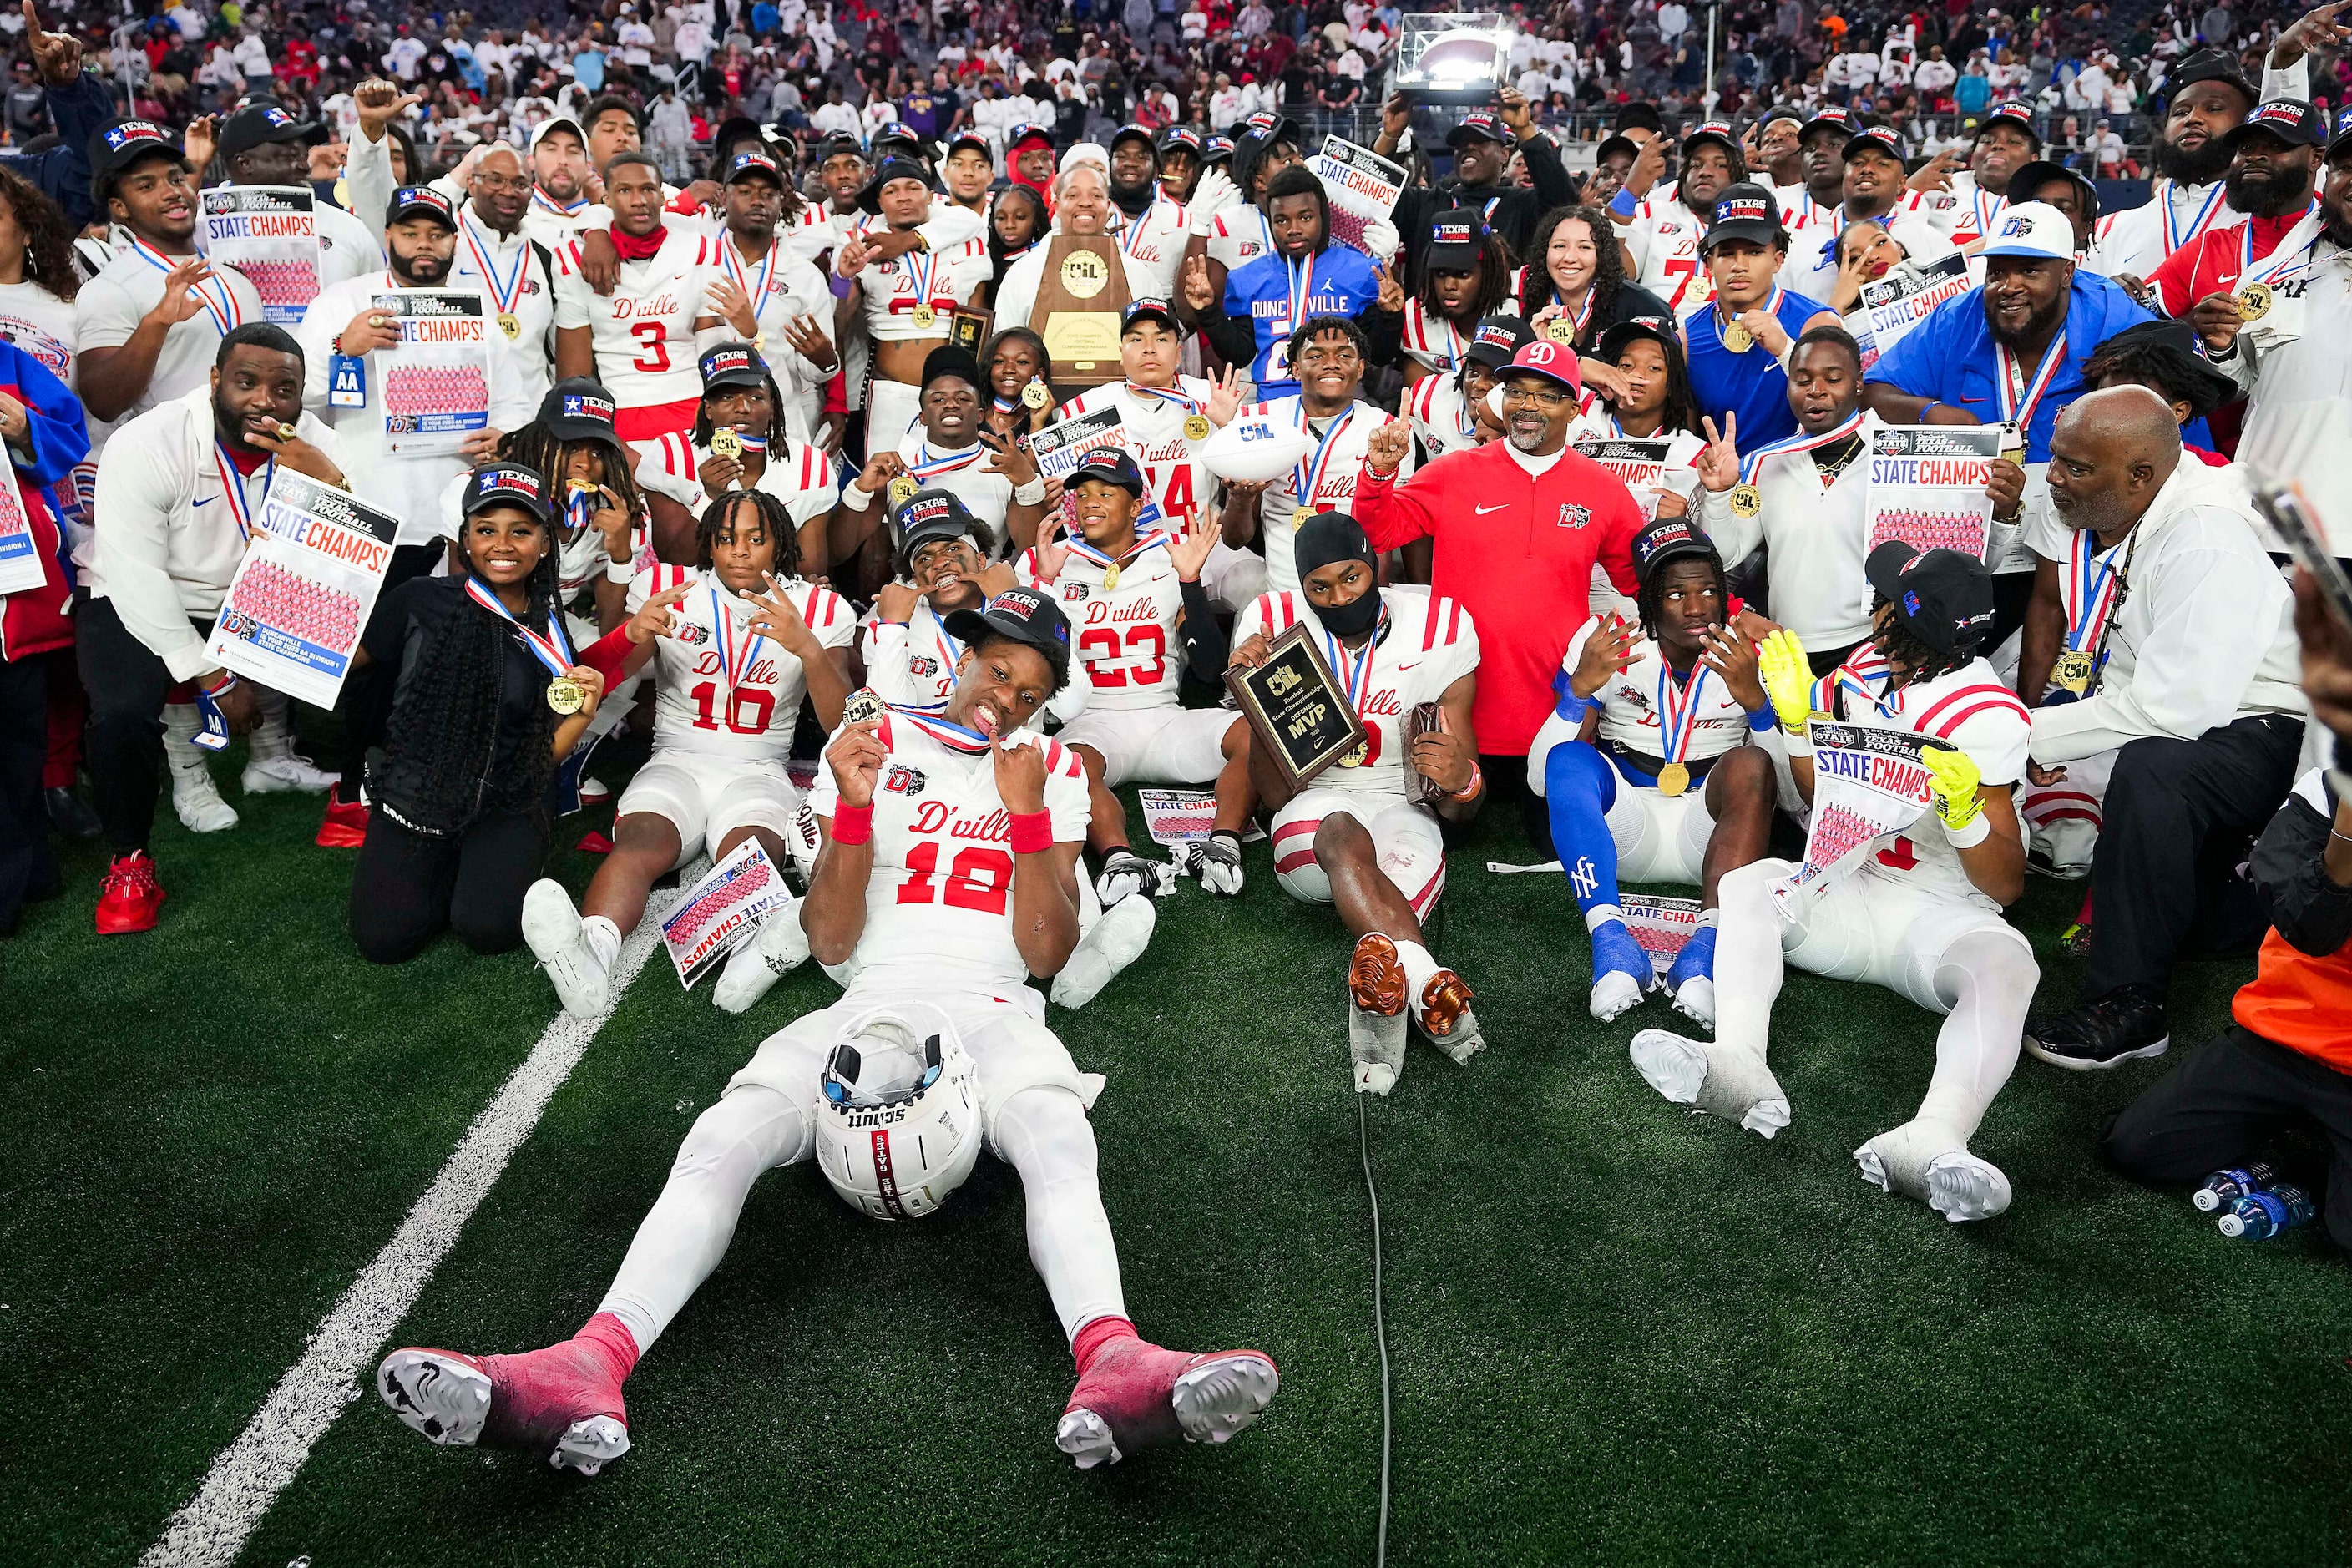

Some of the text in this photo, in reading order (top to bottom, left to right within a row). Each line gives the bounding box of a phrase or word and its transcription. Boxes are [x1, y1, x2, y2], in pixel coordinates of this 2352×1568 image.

[1819, 109, 1847, 118] TEXAS
[2004, 103, 2032, 115] TEXAS
[2259, 110, 2300, 124] STRONG
[2265, 103, 2304, 117] TEXAS
[1702, 121, 1731, 131] TEXAS
[1868, 127, 1898, 141] TEXAS
[748, 154, 776, 166] TEXAS
[1317, 159, 1398, 207] STATE CHAMPS!
[1730, 199, 1766, 209] TEXAS
[1730, 208, 1765, 217] STRONG
[209, 215, 316, 240] STATE CHAMPS!
[1441, 225, 1470, 234] TEXAS
[612, 294, 679, 320] D'ville
[1138, 299, 1168, 308] TEXAS
[1252, 296, 1348, 318] DUNCVILLE
[1871, 301, 1914, 333] STATE
[419, 321, 484, 341] CHAMPS!
[1485, 326, 1517, 340] TEXAS
[1552, 326, 1569, 339] UIL
[630, 321, 670, 372] 3
[1483, 333, 1513, 348] STRONG
[714, 351, 748, 364] TEXAS
[1527, 342, 1555, 364] D
[715, 359, 749, 371] STRONG
[336, 372, 359, 391] AA
[582, 396, 615, 413] TEXAS
[1239, 422, 1274, 442] UIL
[718, 438, 736, 450] UIL
[1874, 439, 1907, 448] STATE
[1914, 445, 1975, 453] FOOTBALL
[1042, 448, 1078, 477] STATE
[1087, 456, 1118, 468] STRONG
[1088, 450, 1120, 462] TEXAS
[498, 470, 539, 488] TEXAS
[1871, 459, 1995, 485] STATE CHAMPS
[498, 479, 539, 497] STRONG
[315, 497, 351, 514] TEXAS
[910, 497, 948, 512] TEXAS
[1736, 493, 1754, 508] UIL
[310, 503, 373, 534] FOOTBALL
[913, 505, 949, 521] STRONG
[261, 503, 388, 574] STATE CHAMPS!
[1648, 522, 1688, 541] TEXAS
[1652, 529, 1691, 548] STRONG
[992, 599, 1034, 619] STRONG
[999, 591, 1041, 610] TEXAS
[1084, 596, 1159, 625] D'ville
[261, 627, 302, 648] DUNCANVILLE
[257, 639, 275, 651] STATE
[275, 645, 311, 665] CHAMPIONS
[267, 635, 282, 646] YOUR
[282, 640, 301, 653] 2023
[308, 651, 335, 668] DIVISION
[1080, 624, 1166, 688] 23
[2064, 663, 2088, 678] UIL
[1266, 664, 1302, 697] UIL
[554, 687, 577, 702] UIL
[1272, 684, 1323, 722] State Championships
[1283, 687, 1304, 705] Football
[690, 681, 776, 735] 10
[850, 701, 878, 723] UIL
[1290, 701, 1316, 721] DEFENSE
[207, 713, 223, 735] AA
[1287, 703, 1326, 740] MVP
[1814, 733, 1854, 744] STATE
[1863, 736, 1902, 746] TEXAS
[1864, 742, 1925, 759] FOOTBAL
[1816, 749, 1872, 783] STATE
[884, 764, 913, 794] D
[1146, 800, 1218, 811] STATE CHAM
[740, 890, 791, 921] STATE
[680, 913, 743, 974] CHAMPS!
[876, 1135, 894, 1197] THE GATES
